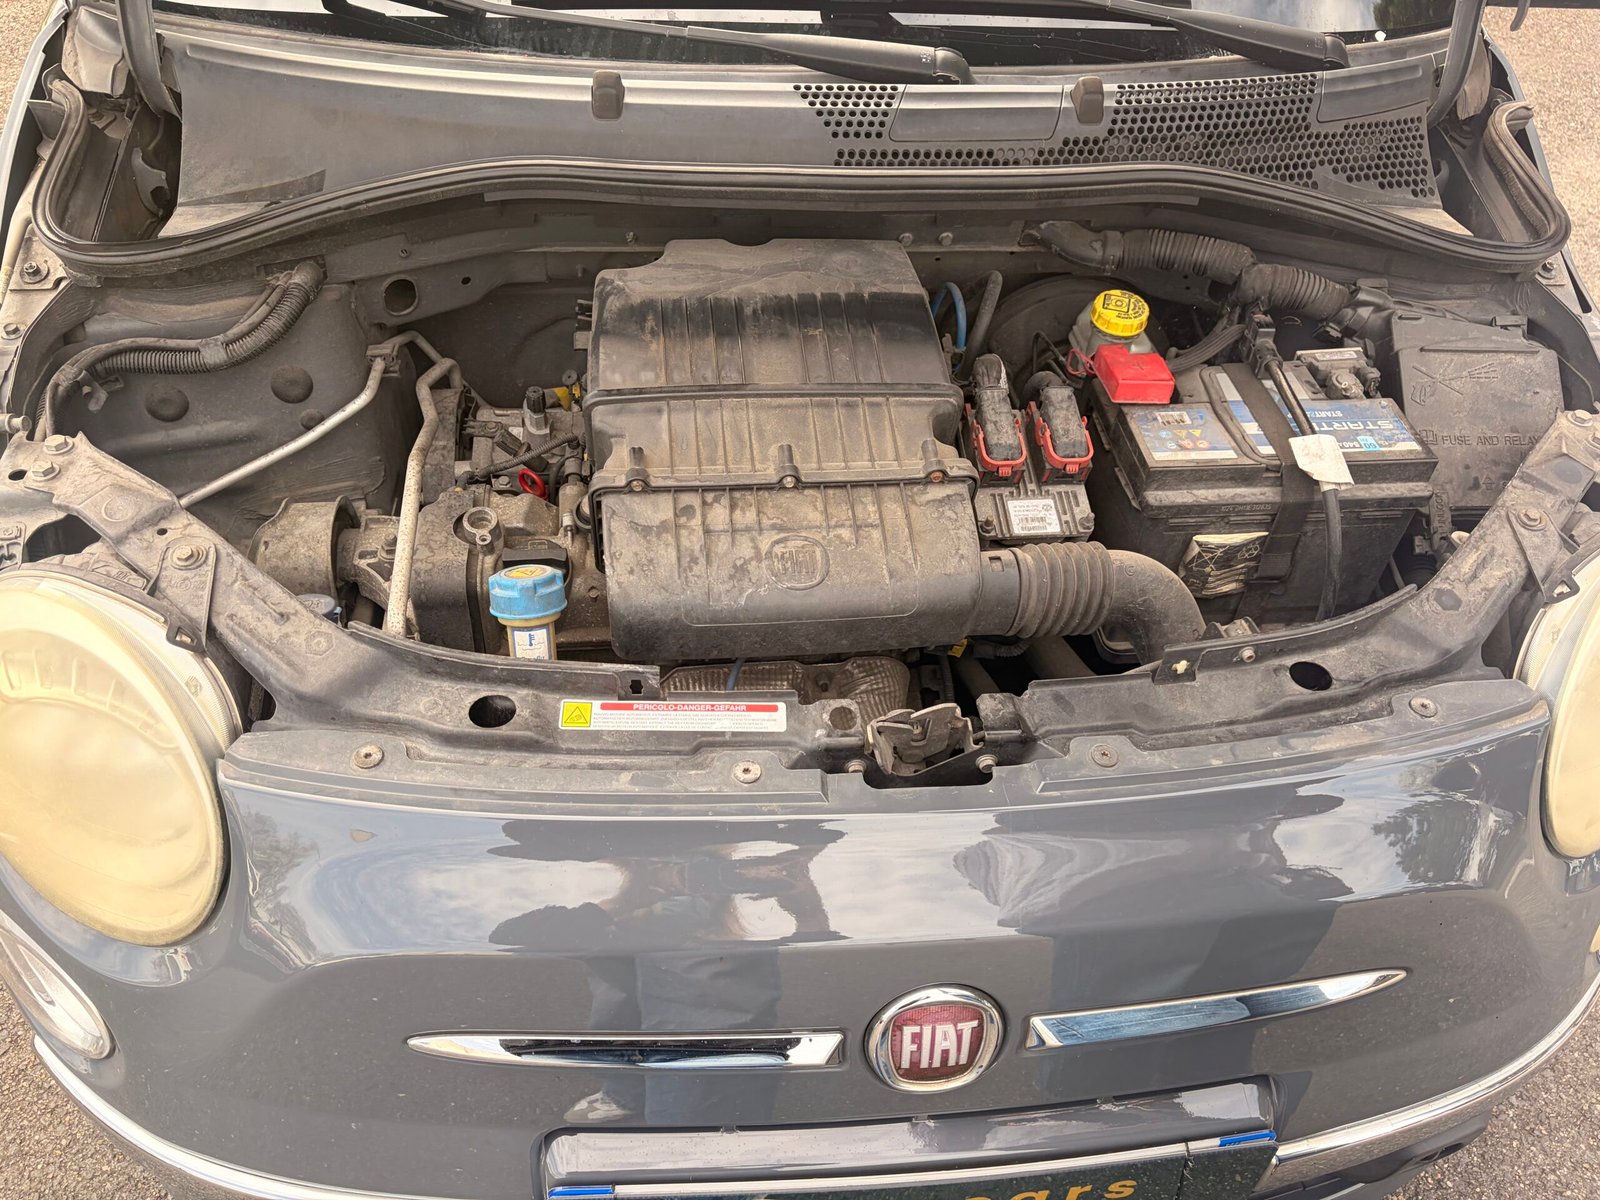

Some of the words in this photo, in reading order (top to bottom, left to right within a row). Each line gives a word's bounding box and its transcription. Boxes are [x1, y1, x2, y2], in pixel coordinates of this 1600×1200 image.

[1442, 435, 1472, 446] FUSE
[1477, 435, 1500, 446] AND
[1504, 435, 1539, 446] RELAY
[632, 703, 747, 713] PERICOLO-DANGER-GEFAHR
[901, 1020, 979, 1069] FIAT
[965, 1179, 1138, 1200] ars
